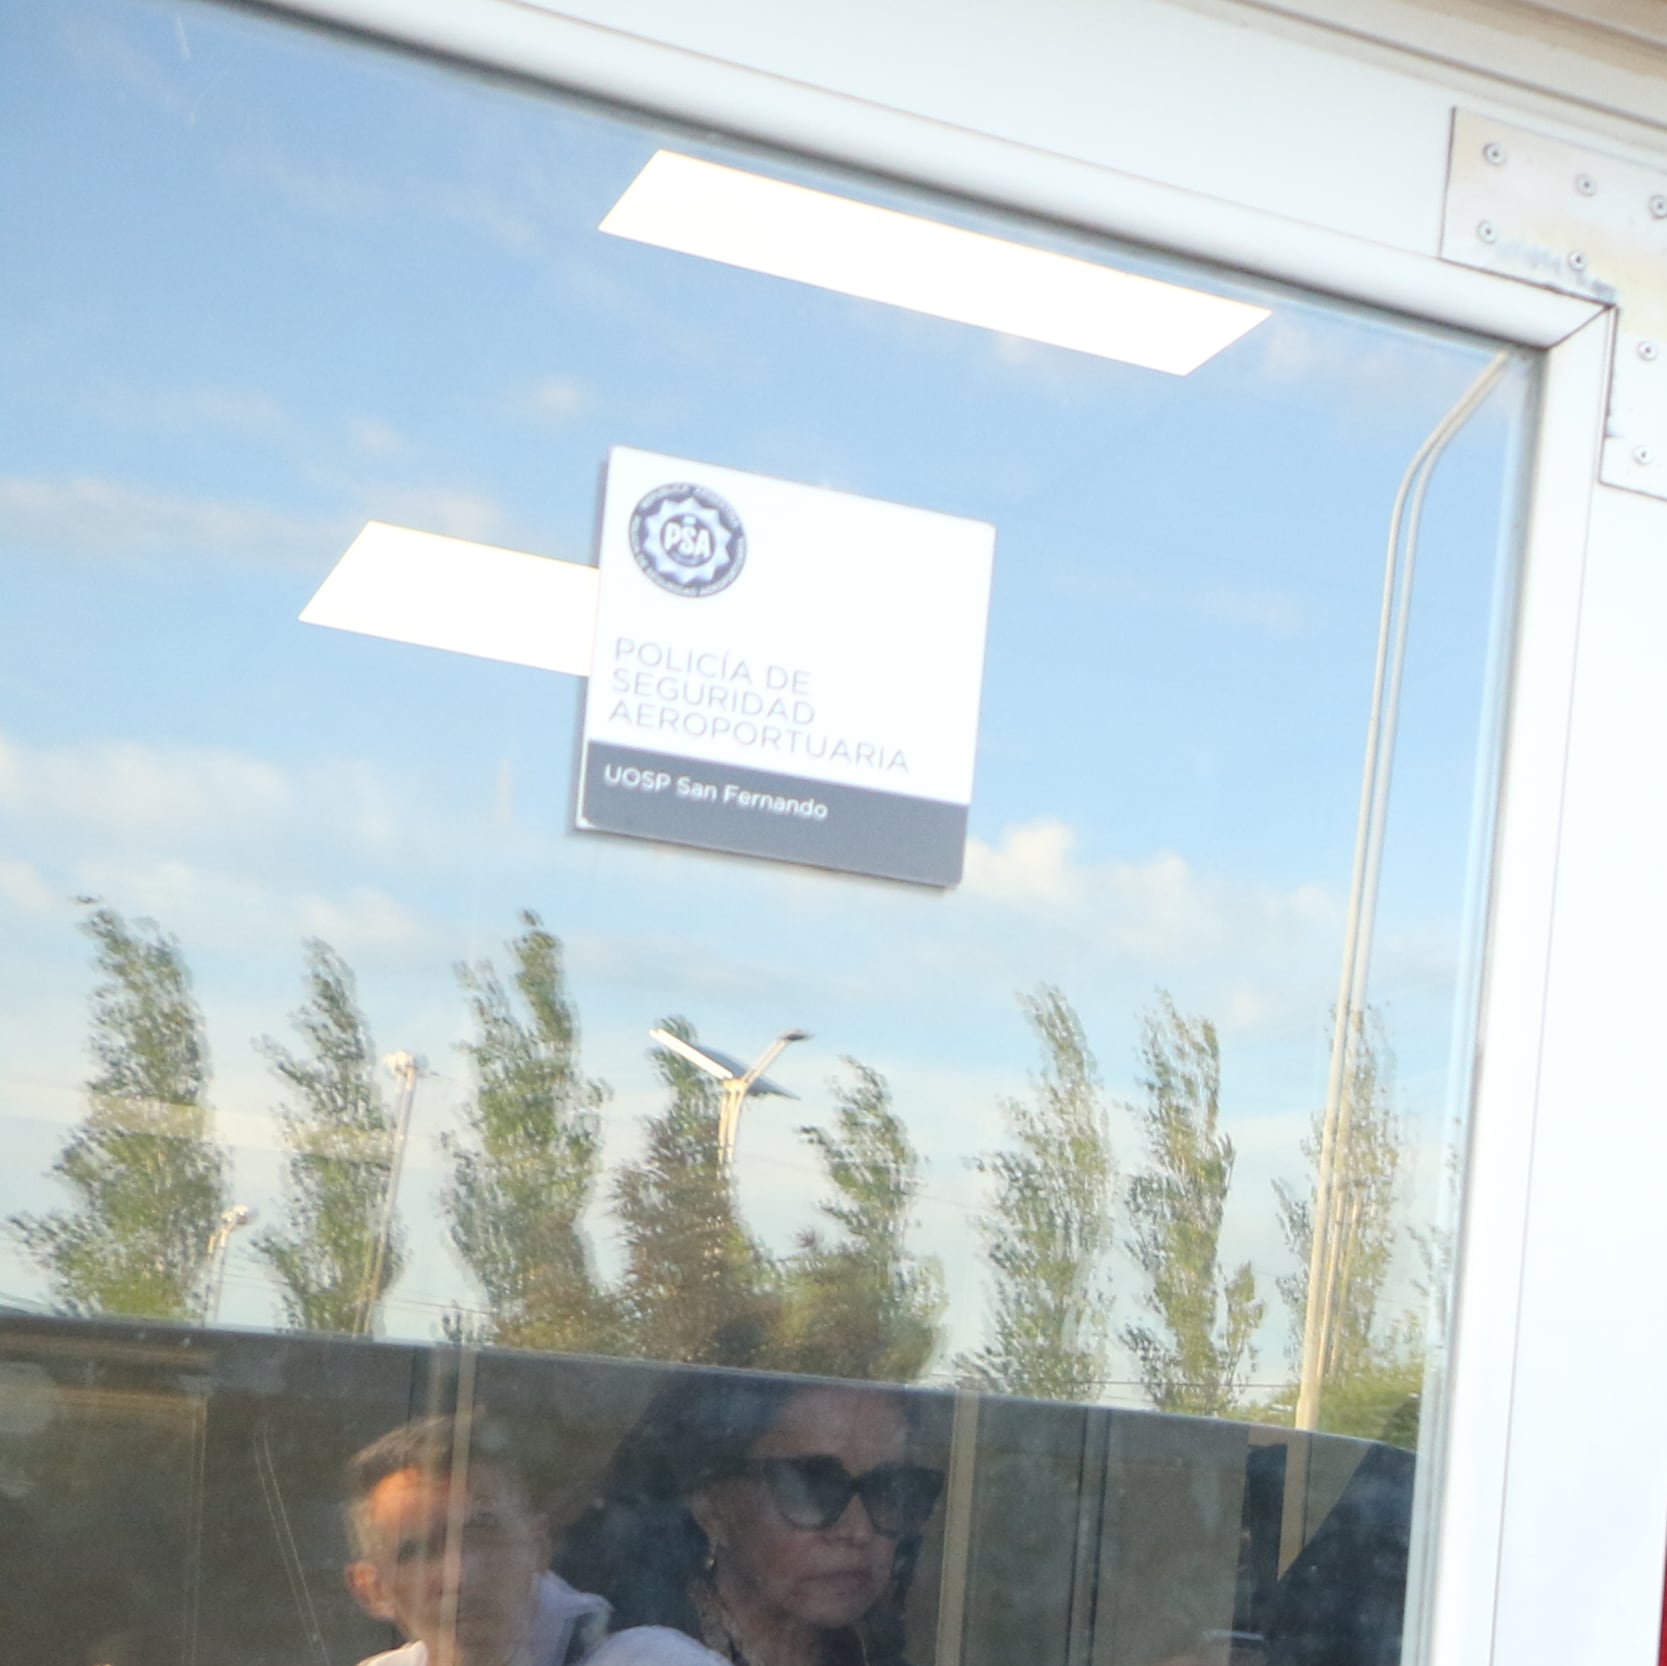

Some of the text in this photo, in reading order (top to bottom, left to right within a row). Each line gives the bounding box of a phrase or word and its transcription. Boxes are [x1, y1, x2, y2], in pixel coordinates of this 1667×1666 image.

[663, 521, 711, 558] PSA
[614, 636, 811, 695] POLICÍA DE
[611, 667, 815, 726] SEGURIDAD
[608, 699, 910, 774] AEROPORTUARIA
[604, 763, 829, 820] UOSP San Fernando
